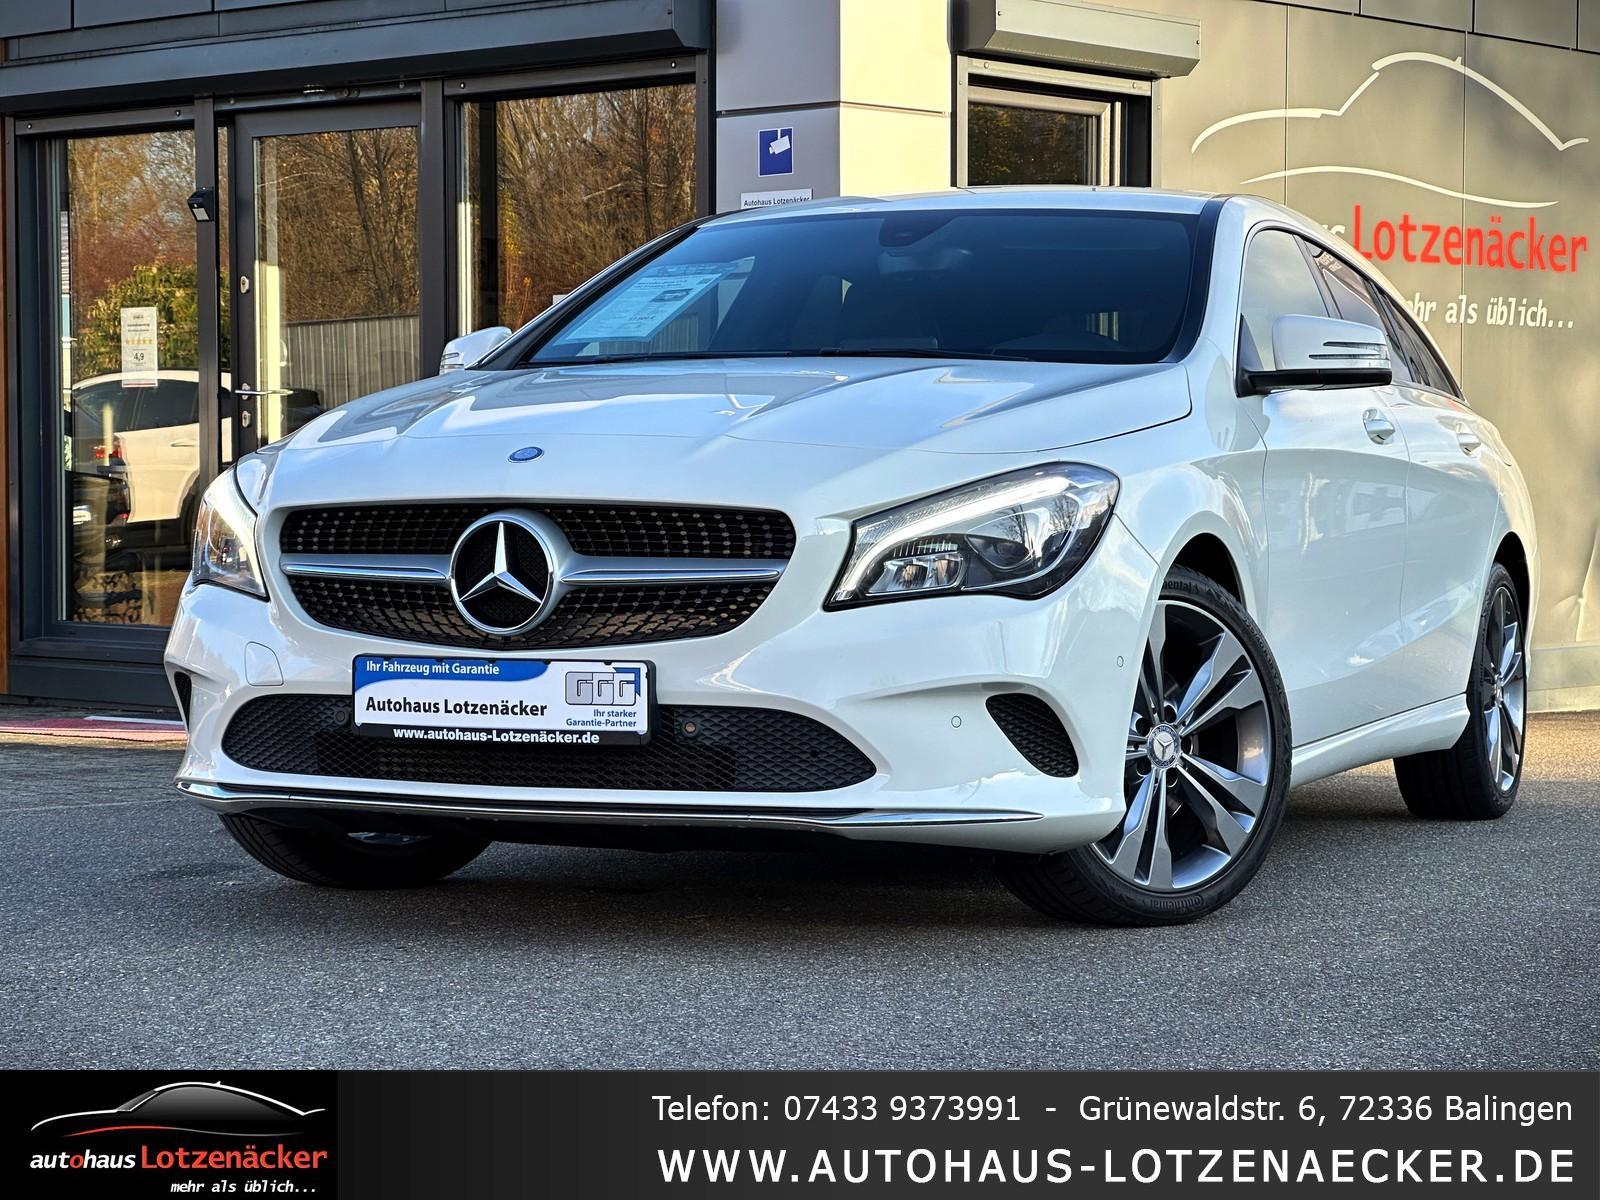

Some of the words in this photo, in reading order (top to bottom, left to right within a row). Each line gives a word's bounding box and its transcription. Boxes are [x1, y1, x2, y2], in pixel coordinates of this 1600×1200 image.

[743, 199, 772, 207] Autohaus
[1354, 204, 1588, 273] Lotzenäcker
[1445, 295, 1478, 324] als
[1486, 297, 1574, 328] üblich...
[366, 661, 381, 672] Ihr
[382, 661, 430, 676] Fahrzeug
[432, 663, 450, 674] mit
[452, 663, 500, 675] Garantie
[365, 696, 440, 714] Autohaus
[444, 699, 548, 717] Lotzenäcker
[593, 709, 606, 718] Ihr
[607, 709, 637, 718] starker
[566, 718, 637, 728] Garantie-Partner
[393, 726, 600, 744] www.autohaus-Lotzenäcker.de
